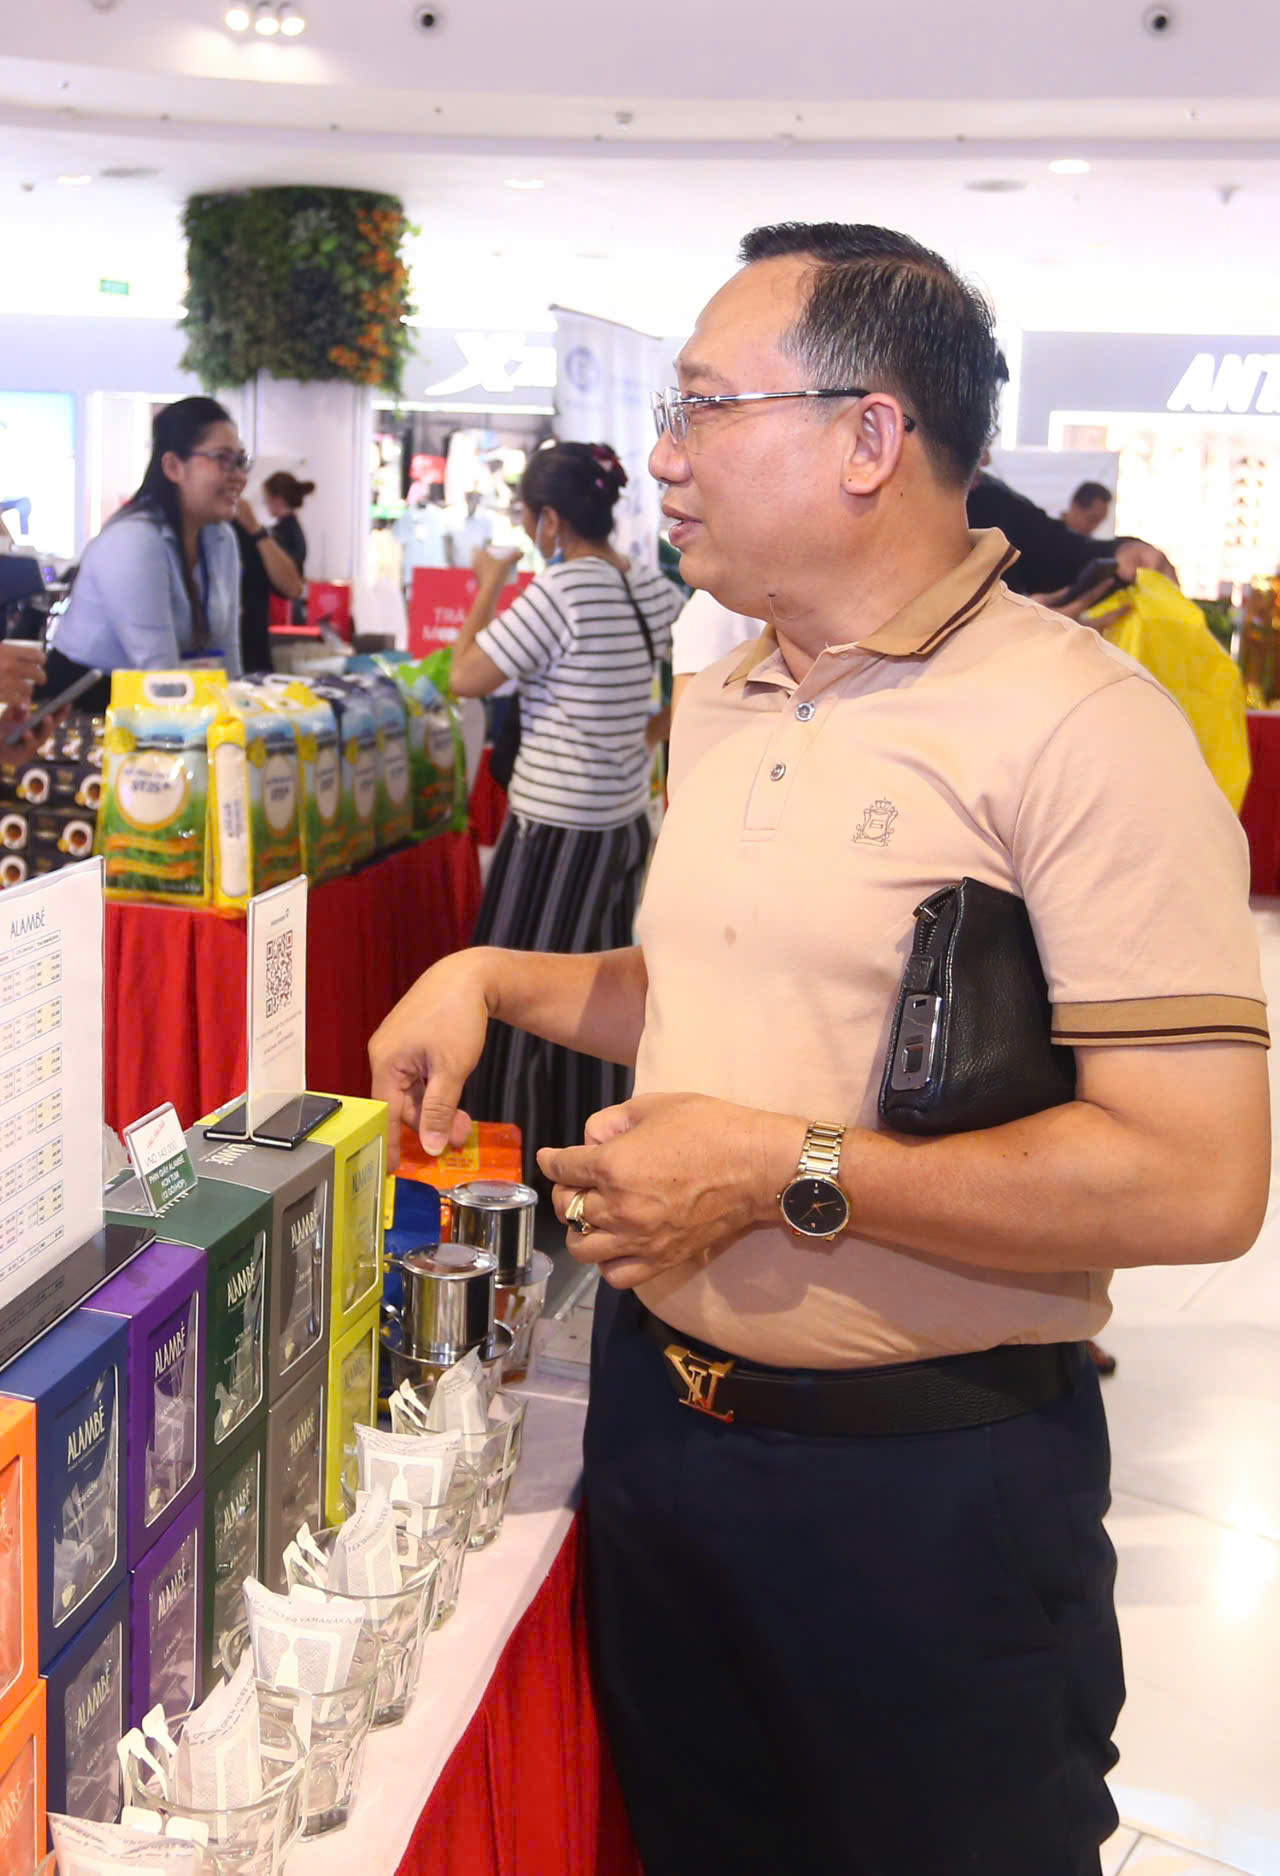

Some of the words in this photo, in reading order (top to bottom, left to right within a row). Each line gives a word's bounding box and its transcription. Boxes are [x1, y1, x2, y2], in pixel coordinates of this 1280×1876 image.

[9, 906, 46, 940] ALAMBÉ
[154, 1320, 186, 1378] ALAMBÉ
[67, 1399, 106, 1465] ALAMBÉ
